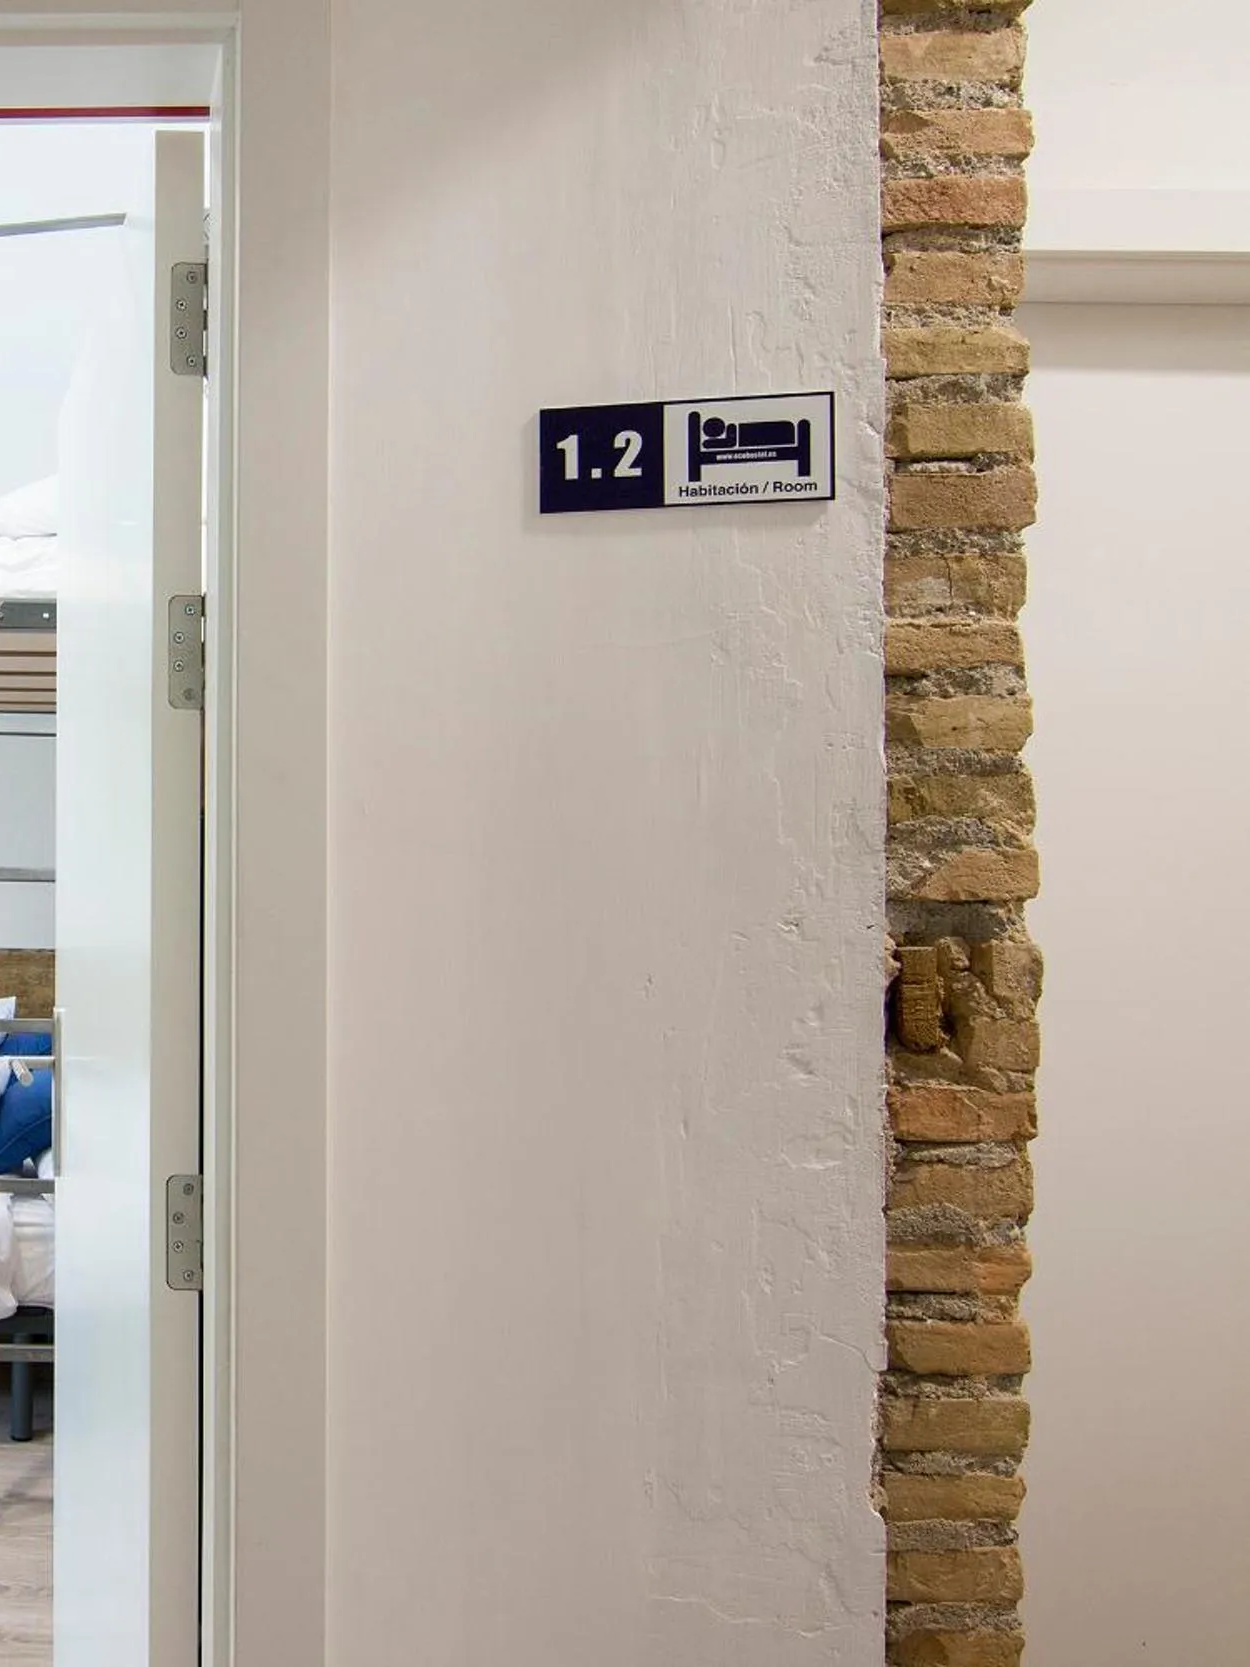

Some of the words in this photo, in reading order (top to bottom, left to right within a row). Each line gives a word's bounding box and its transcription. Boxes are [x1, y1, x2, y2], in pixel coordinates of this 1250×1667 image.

[556, 430, 643, 480] 1.2
[678, 482, 759, 498] Habitación
[762, 481, 769, 494] /
[772, 481, 818, 493] Room
